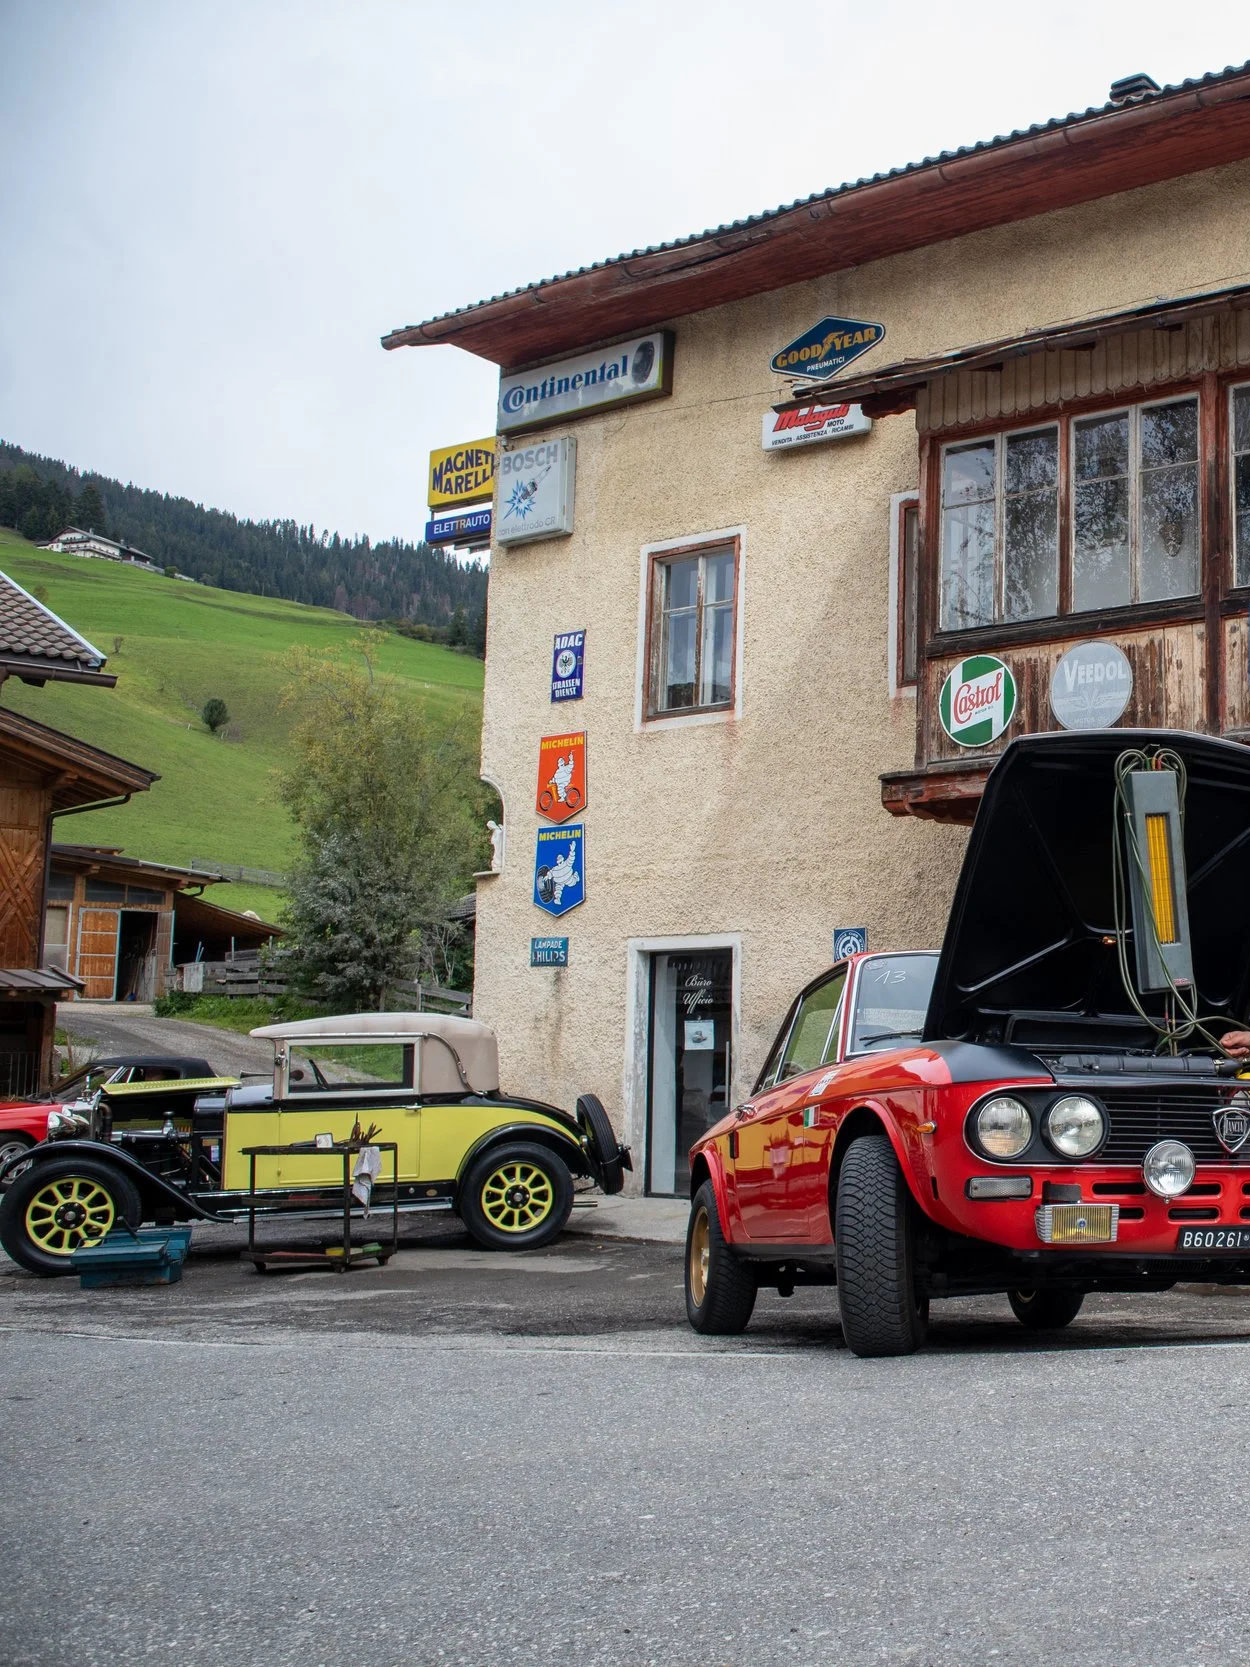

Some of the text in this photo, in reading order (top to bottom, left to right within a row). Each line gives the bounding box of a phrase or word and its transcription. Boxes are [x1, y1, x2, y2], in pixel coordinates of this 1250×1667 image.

[806, 356, 845, 372] PNEUMATICI
[502, 354, 628, 414] Continental
[826, 418, 845, 428] MOTO
[771, 423, 854, 446] VENDITA ASSISTENZA RICAMBI
[502, 443, 559, 475] BOSCH
[433, 513, 491, 534] ELETTRAUTO
[554, 633, 583, 650] ADAC
[1063, 659, 1128, 692] VEEDOL
[552, 678, 581, 690] STRASSEN
[555, 686, 577, 698] DIENST
[953, 672, 1003, 724] Castrol
[541, 735, 584, 750] MICHELIN
[539, 829, 582, 841] MICHELIN
[534, 940, 563, 949] LAMPADE
[685, 973, 713, 987] Büro
[873, 970, 907, 985] 13
[682, 988, 714, 1014] Ufficio
